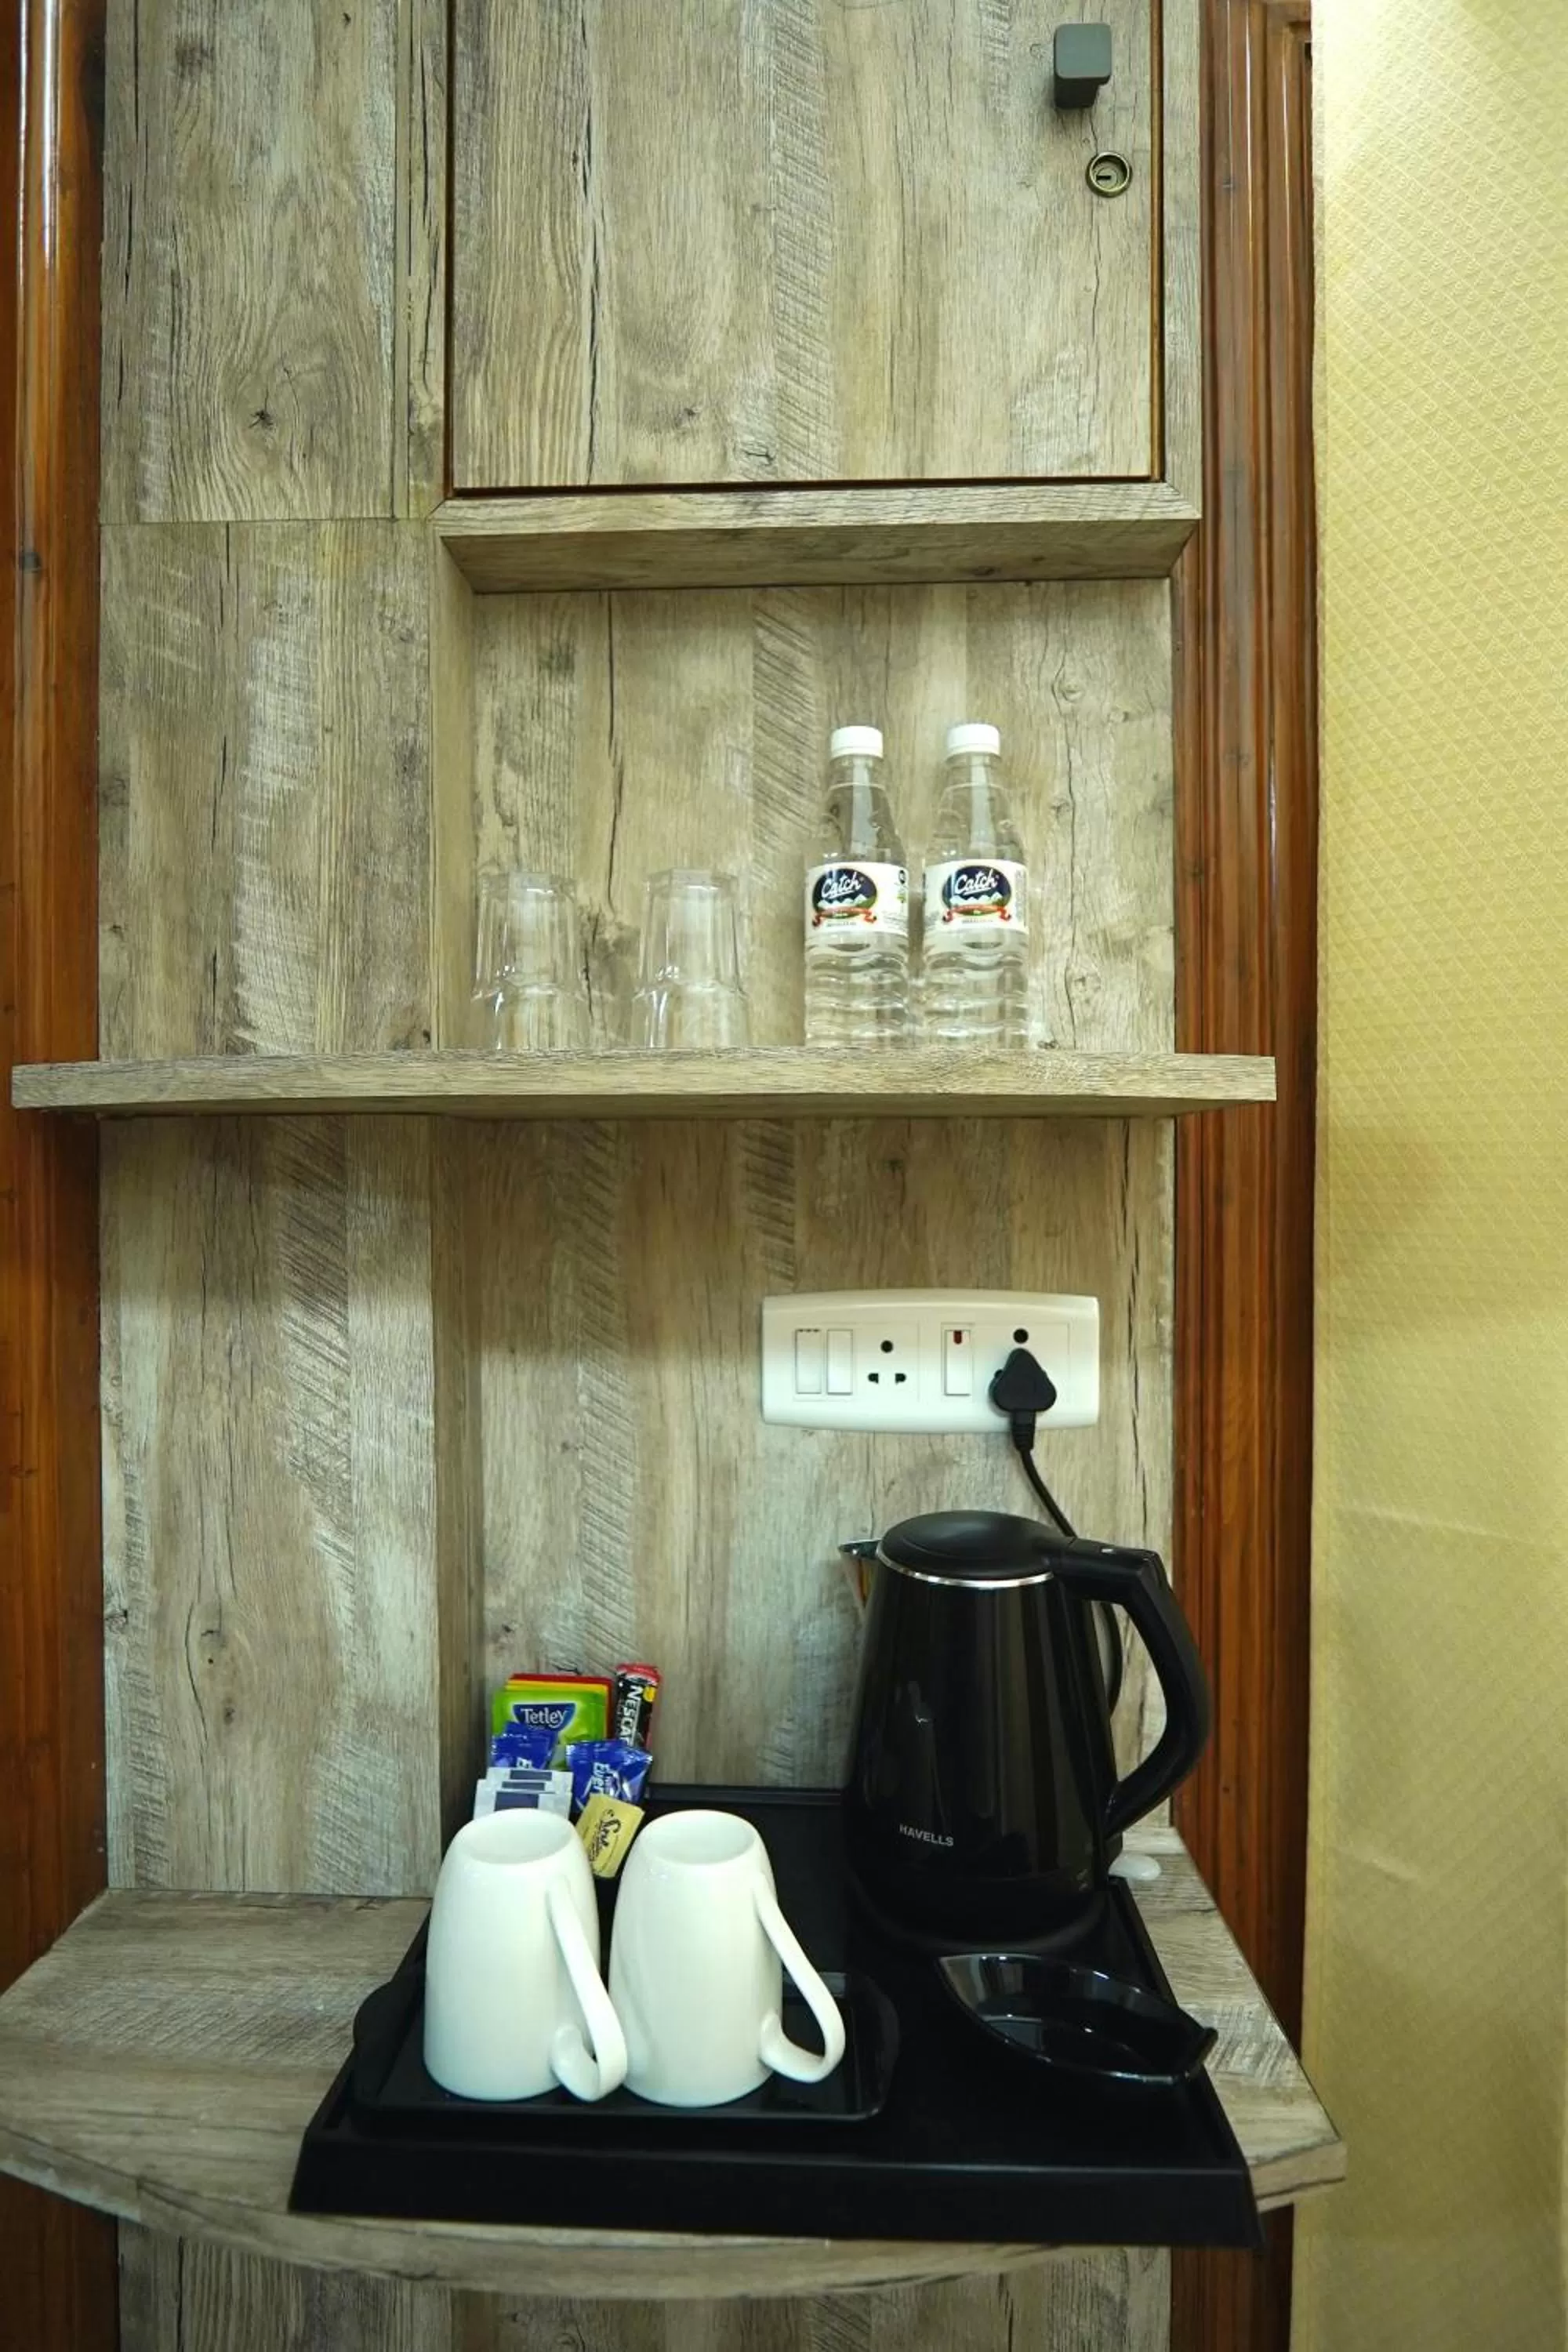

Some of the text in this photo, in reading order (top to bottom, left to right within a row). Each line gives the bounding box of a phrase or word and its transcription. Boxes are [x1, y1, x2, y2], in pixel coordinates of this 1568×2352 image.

[821, 871, 862, 898] Catch
[955, 869, 998, 895] Catch
[520, 1707, 568, 1729] Tetley
[619, 1685, 644, 1747] NESCAF
[899, 1823, 954, 1846] HAVELLS
